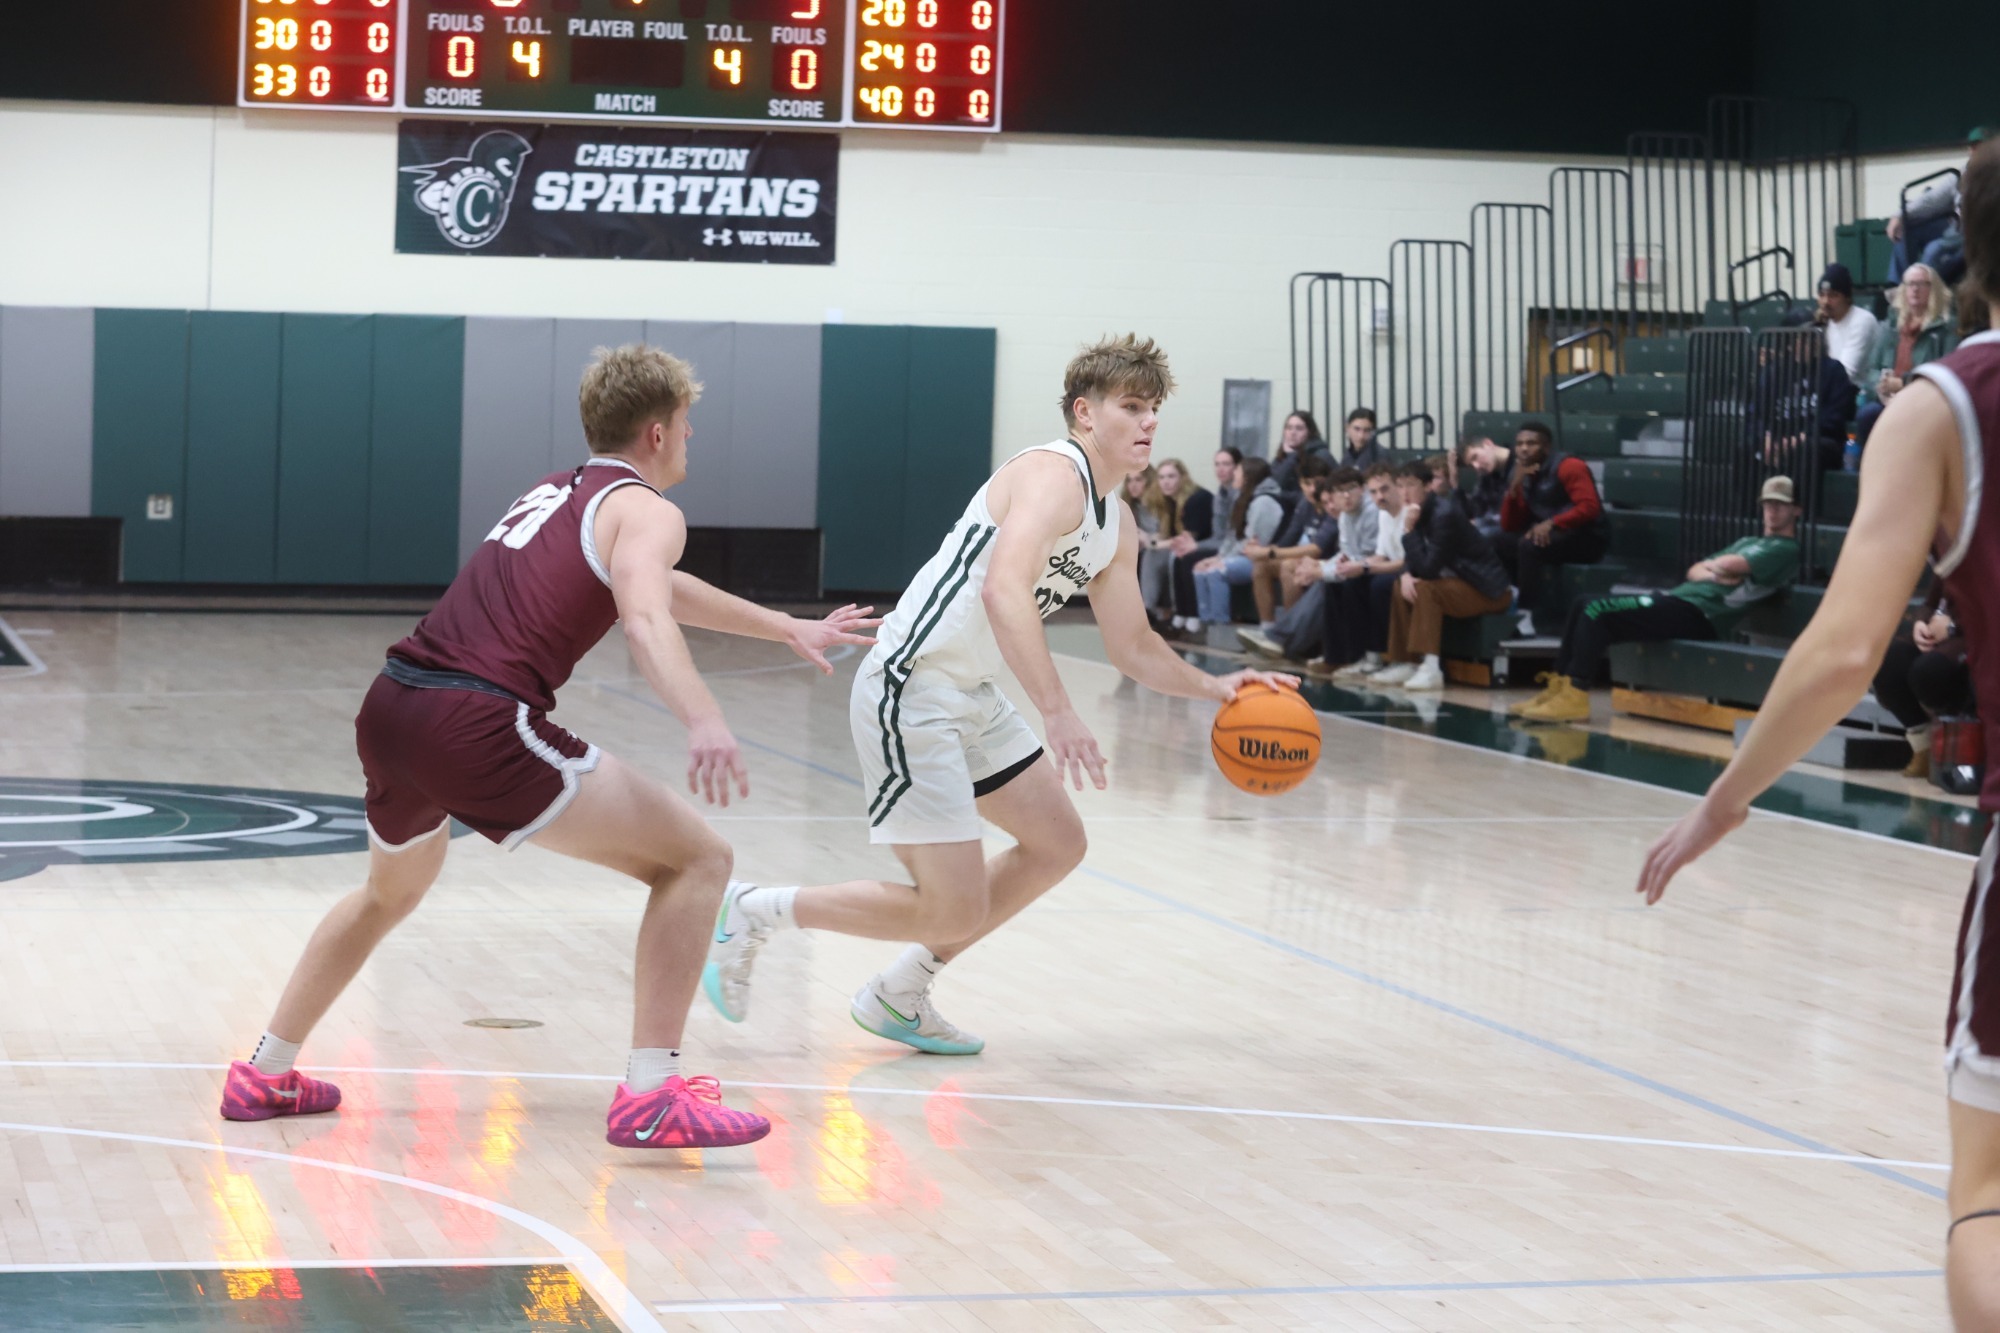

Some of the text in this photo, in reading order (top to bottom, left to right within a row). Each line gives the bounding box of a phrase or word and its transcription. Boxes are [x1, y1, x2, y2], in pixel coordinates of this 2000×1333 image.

[427, 13, 484, 32] FOULS
[504, 16, 551, 35] T.O.L.
[568, 18, 688, 40] PLAYER FOUL
[861, 0, 992, 30] 20 0 0
[255, 17, 389, 53] 30 0 0
[706, 24, 752, 43] T.O.L.
[771, 26, 827, 46] FOULS
[448, 36, 475, 78] 0
[512, 41, 540, 78] 4
[713, 48, 741, 85] 4
[791, 49, 817, 90] 0
[860, 40, 991, 75] 24 0 0
[254, 64, 388, 98] 33 0 0
[425, 87, 482, 106] SCORE
[595, 93, 656, 112] MATCH
[768, 99, 824, 119] SCORE
[859, 85, 989, 119] 40 0 0
[574, 143, 750, 172] CASTLETON
[532, 172, 820, 218] SPARTANS
[737, 230, 768, 246] WE
[1239, 736, 1309, 761] Wilson
